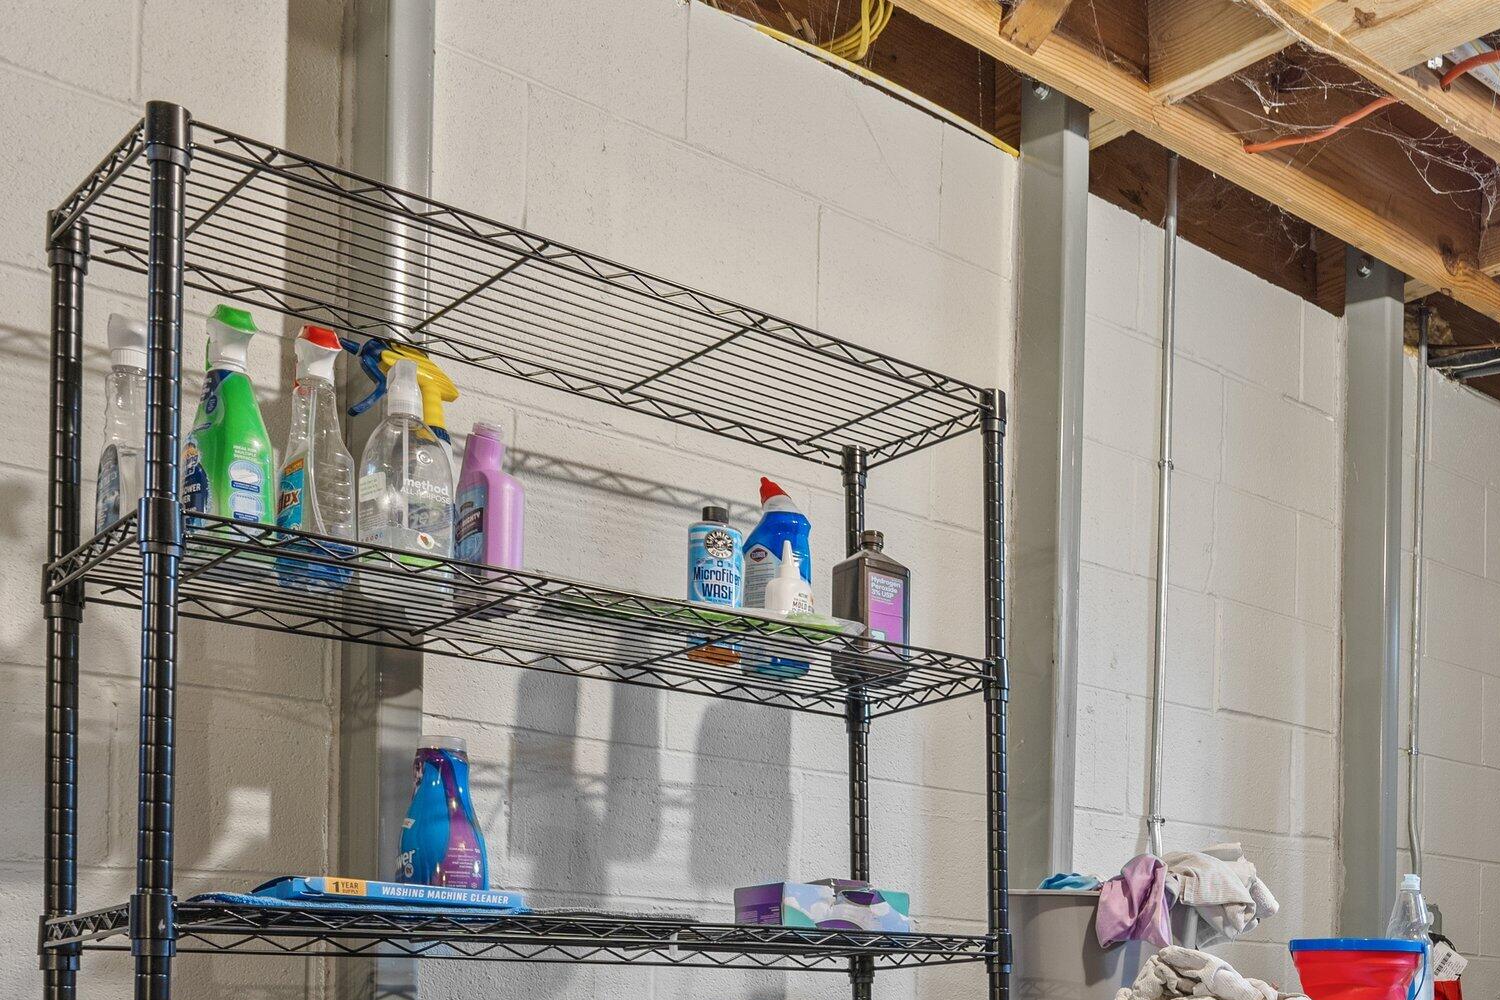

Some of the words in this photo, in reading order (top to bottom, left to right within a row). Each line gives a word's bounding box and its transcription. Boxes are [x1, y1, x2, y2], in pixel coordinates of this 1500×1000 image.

[404, 479, 449, 497] method
[871, 575, 901, 589] Hydrogen
[871, 583, 898, 594] Peroxide
[701, 582, 734, 600] WASH
[332, 881, 340, 893] 1
[341, 881, 359, 889] YEAR
[382, 886, 425, 898] WASHING
[427, 890, 468, 902] MACHINE
[470, 894, 509, 905] CLEANER
